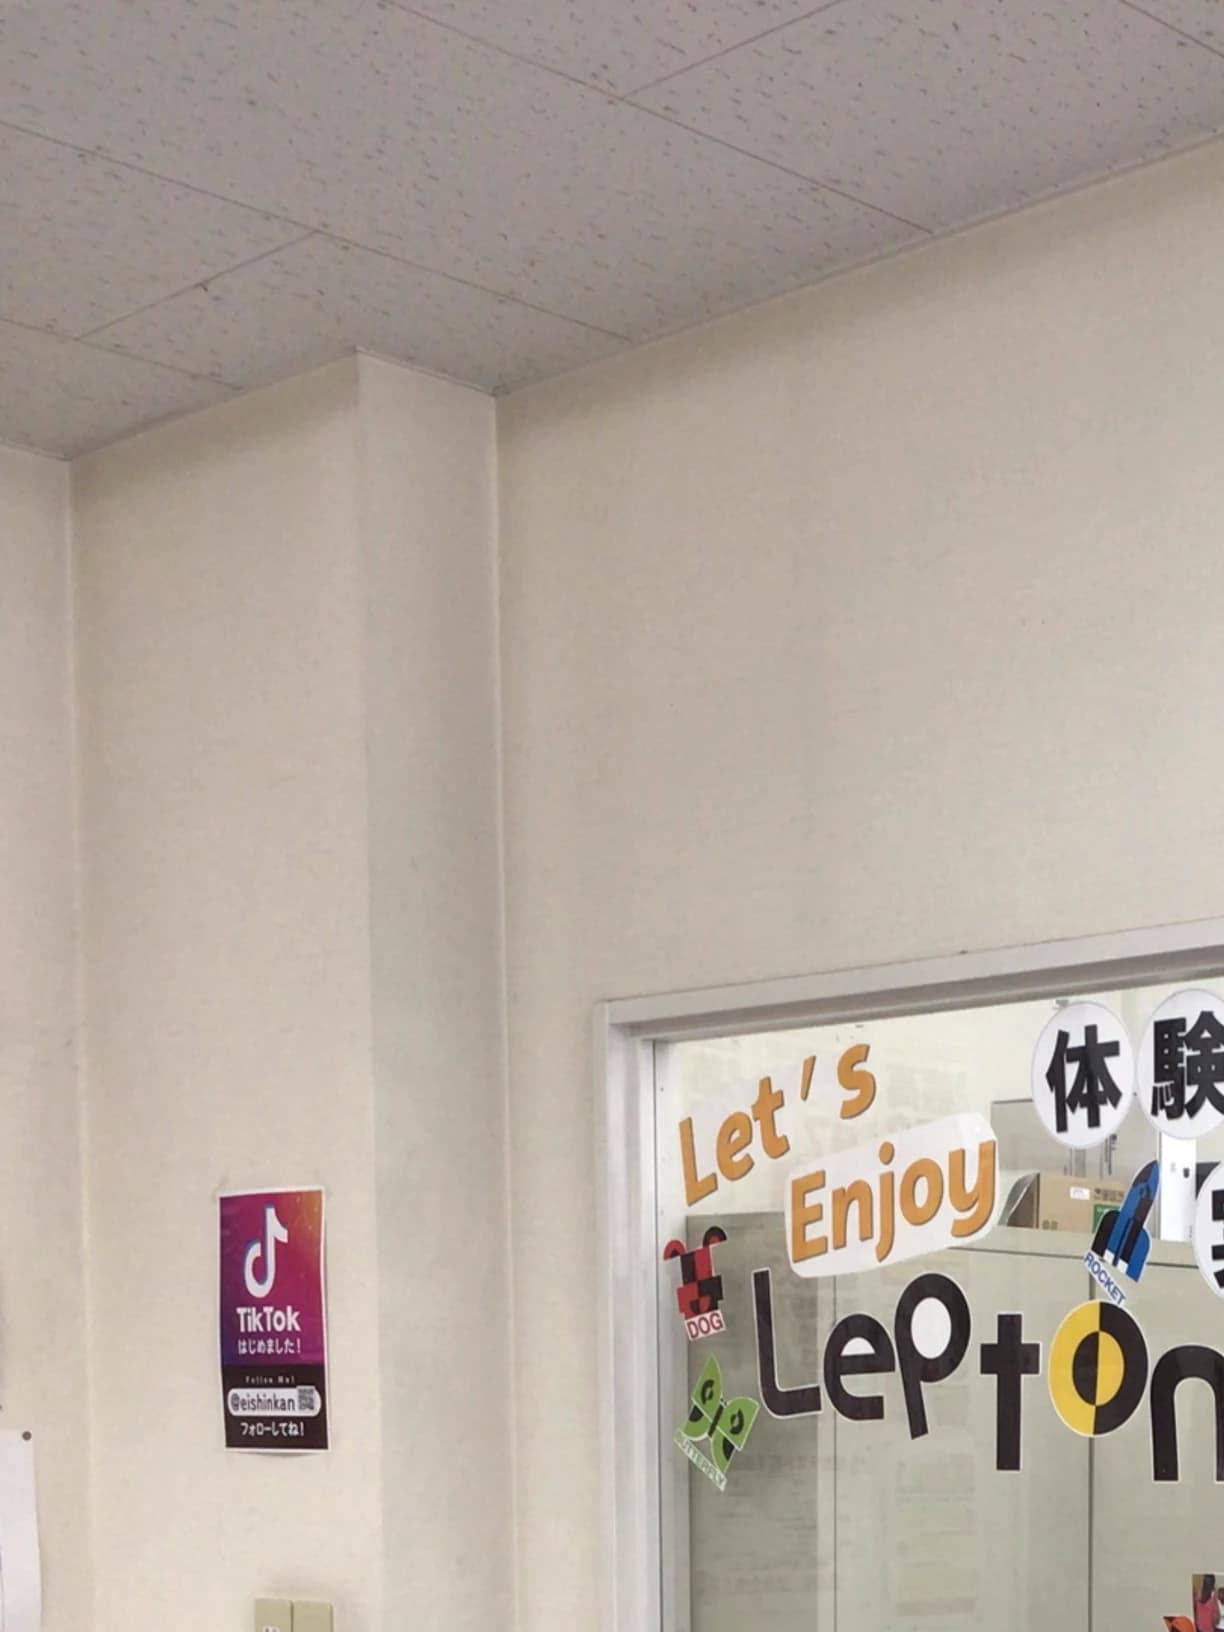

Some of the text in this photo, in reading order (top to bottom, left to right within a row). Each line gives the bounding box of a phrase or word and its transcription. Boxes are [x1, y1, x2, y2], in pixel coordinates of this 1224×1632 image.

[679, 1043, 877, 1206] Let's
[790, 1140, 997, 1263] Enjoy
[1084, 1252, 1127, 1305] ROCKET
[236, 1306, 301, 1332] TikTok
[688, 1312, 724, 1339] DOG
[230, 1393, 296, 1411] @eishinkan
